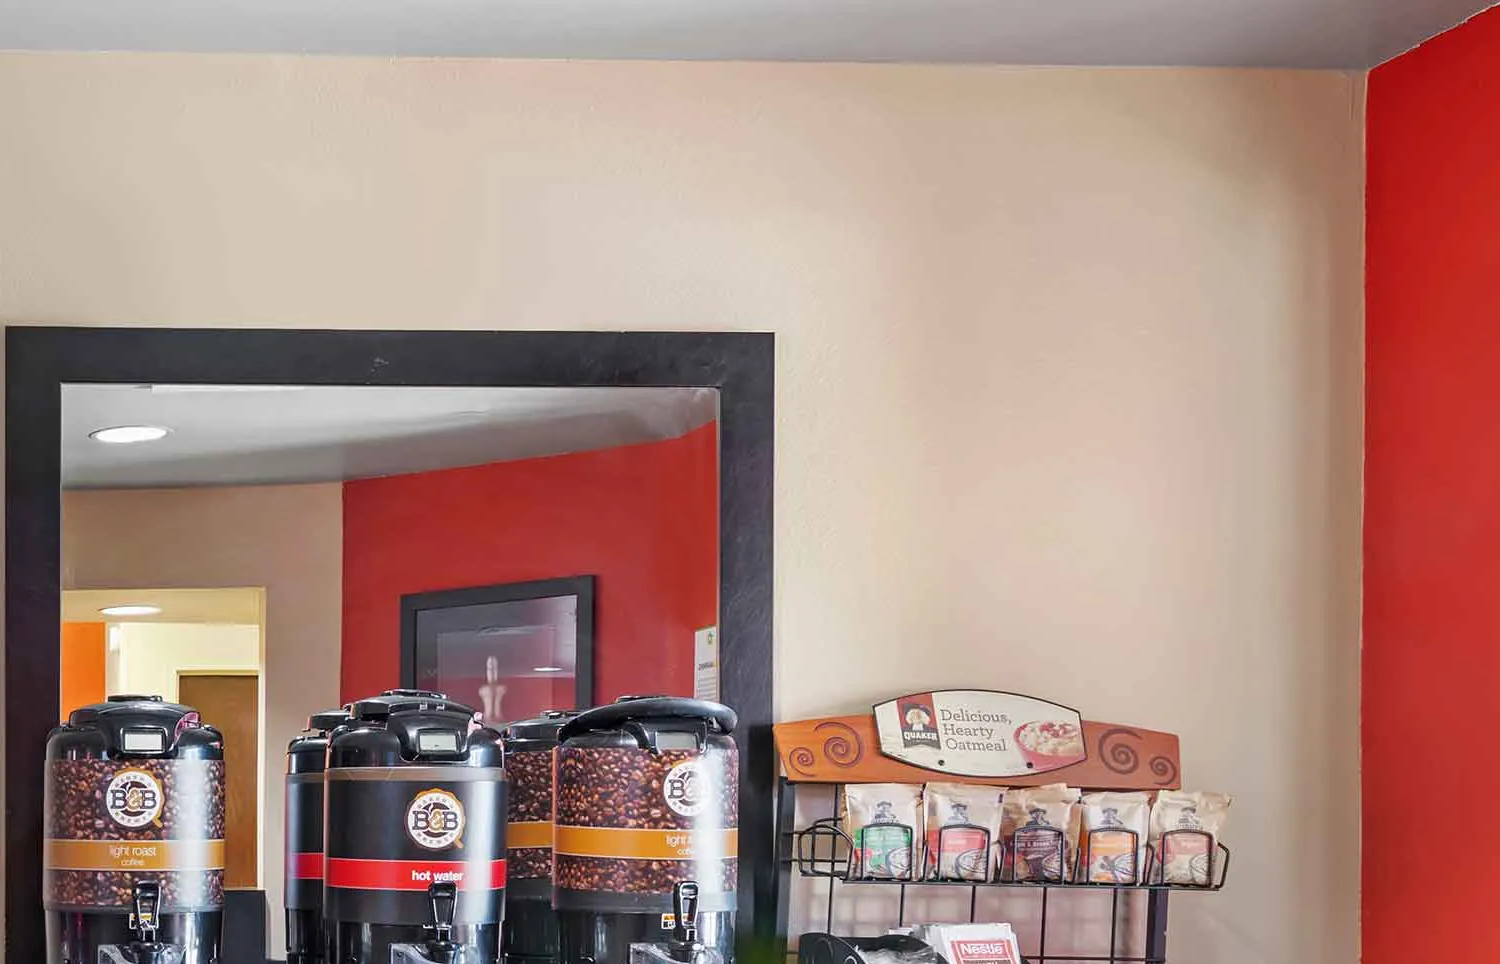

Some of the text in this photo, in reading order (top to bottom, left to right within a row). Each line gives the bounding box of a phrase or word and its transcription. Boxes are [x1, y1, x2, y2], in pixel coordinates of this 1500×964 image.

[939, 708, 1012, 725] Delicious,
[903, 731, 938, 741] QUAKER
[942, 723, 994, 739] Hearty
[946, 738, 1007, 752] Oatmeal
[110, 787, 157, 811] B&B
[411, 809, 458, 832] B&B
[132, 847, 157, 857] roast
[411, 869, 464, 881] hot water
